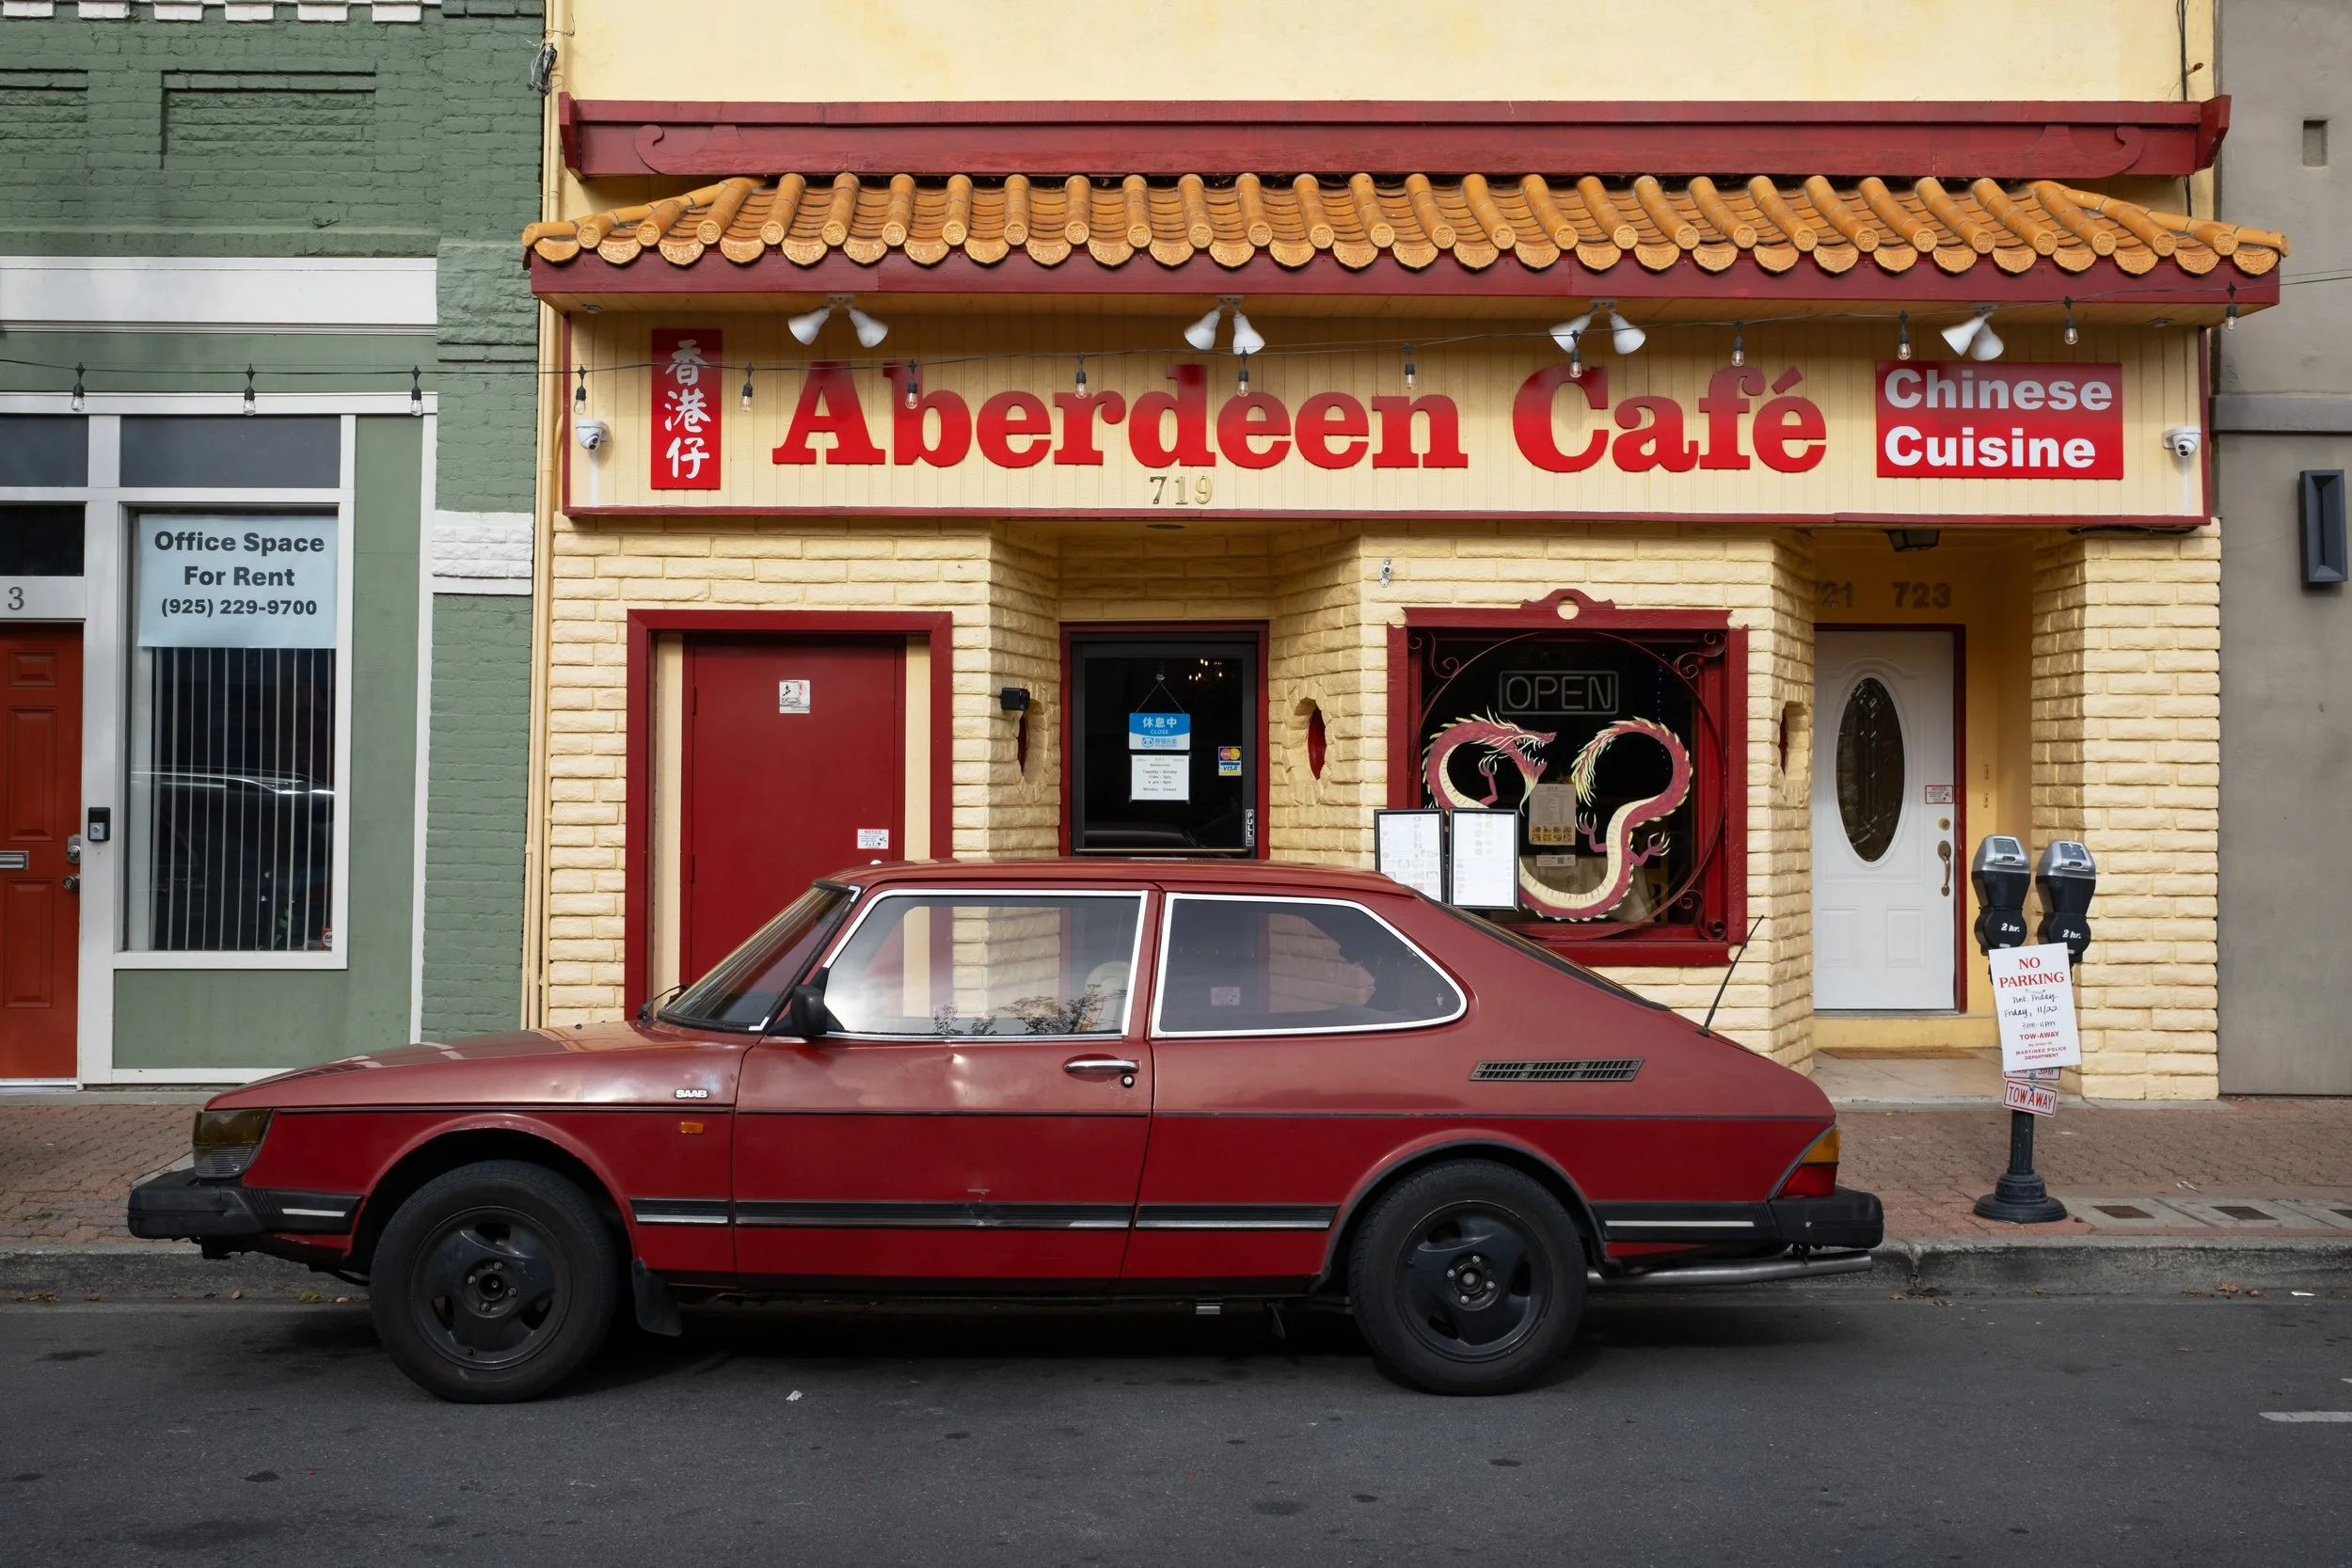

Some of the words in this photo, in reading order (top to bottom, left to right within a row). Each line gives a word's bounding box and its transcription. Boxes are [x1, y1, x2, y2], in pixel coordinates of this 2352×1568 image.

[1884, 368, 2113, 411] Chinese
[664, 340, 711, 479] 香港仔
[772, 361, 1469, 468] Aberdeen
[1512, 366, 1827, 472] Café
[1884, 425, 2096, 468] Cuisine
[1150, 475, 1213, 505] 719
[154, 531, 237, 551] Office
[244, 532, 325, 557] Space
[184, 566, 226, 586] For
[233, 566, 294, 587] Rent
[8, 586, 24, 610] 3
[1891, 581, 1951, 609] 723
[162, 598, 214, 617] (925)
[220, 599, 317, 615] 229-9700
[1506, 676, 1612, 709] OPEN
[1143, 717, 1177, 729] 休息中
[2000, 923, 2008, 931] 2
[2062, 929, 2069, 938] 2
[2070, 930, 2081, 939] hr.
[2018, 957, 2041, 970] NO
[1999, 972, 2065, 989] PARKING
[2031, 993, 2058, 1003] Friday
[2019, 1030, 2059, 1040] TOW-AWAY
[675, 1089, 708, 1099] SAAB
[2009, 1086, 2027, 1104] TOW
[2027, 1091, 2054, 1110] AWAY
